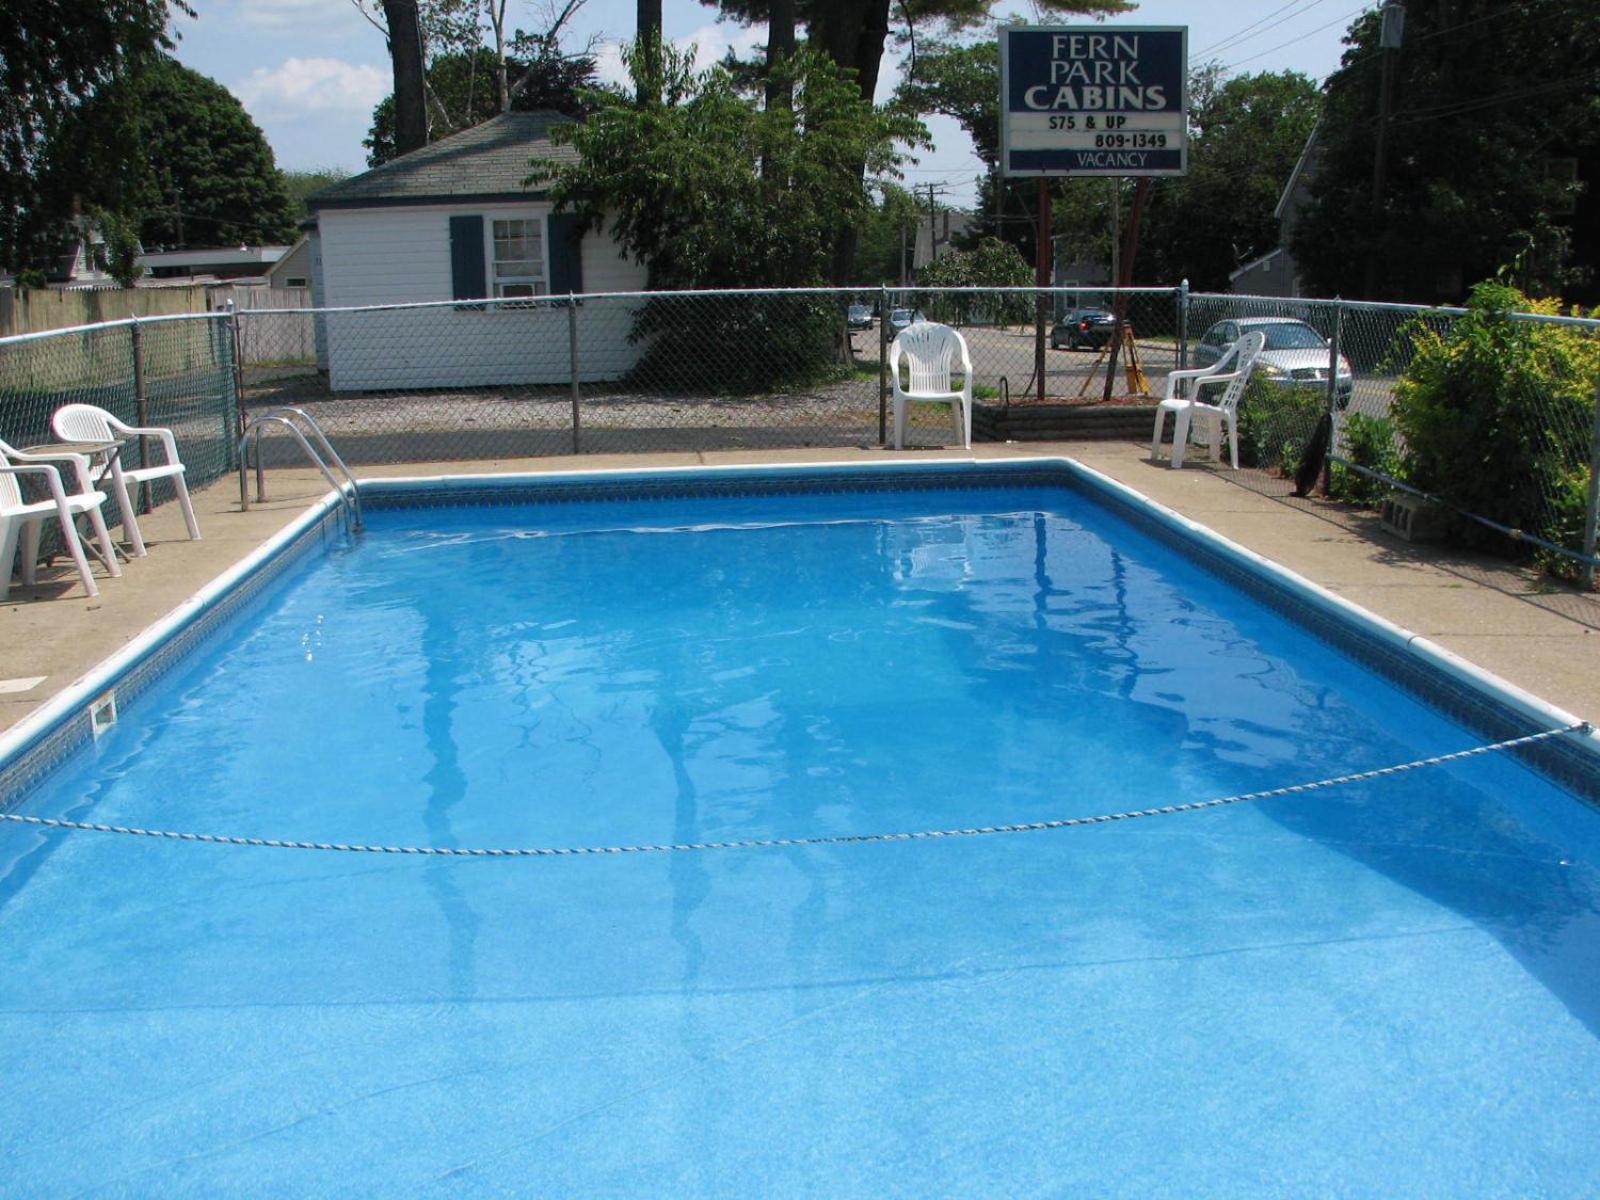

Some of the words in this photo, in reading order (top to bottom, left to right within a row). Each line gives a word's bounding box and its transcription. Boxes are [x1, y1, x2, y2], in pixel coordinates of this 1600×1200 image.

[1052, 35, 1139, 59] FERN
[1050, 61, 1141, 84] PARK
[1024, 85, 1167, 110] CABINS
[1086, 115, 1096, 129] &
[1106, 116, 1126, 129] UP
[1095, 134, 1166, 148] 809-1349
[1077, 152, 1148, 167] VACANCY
